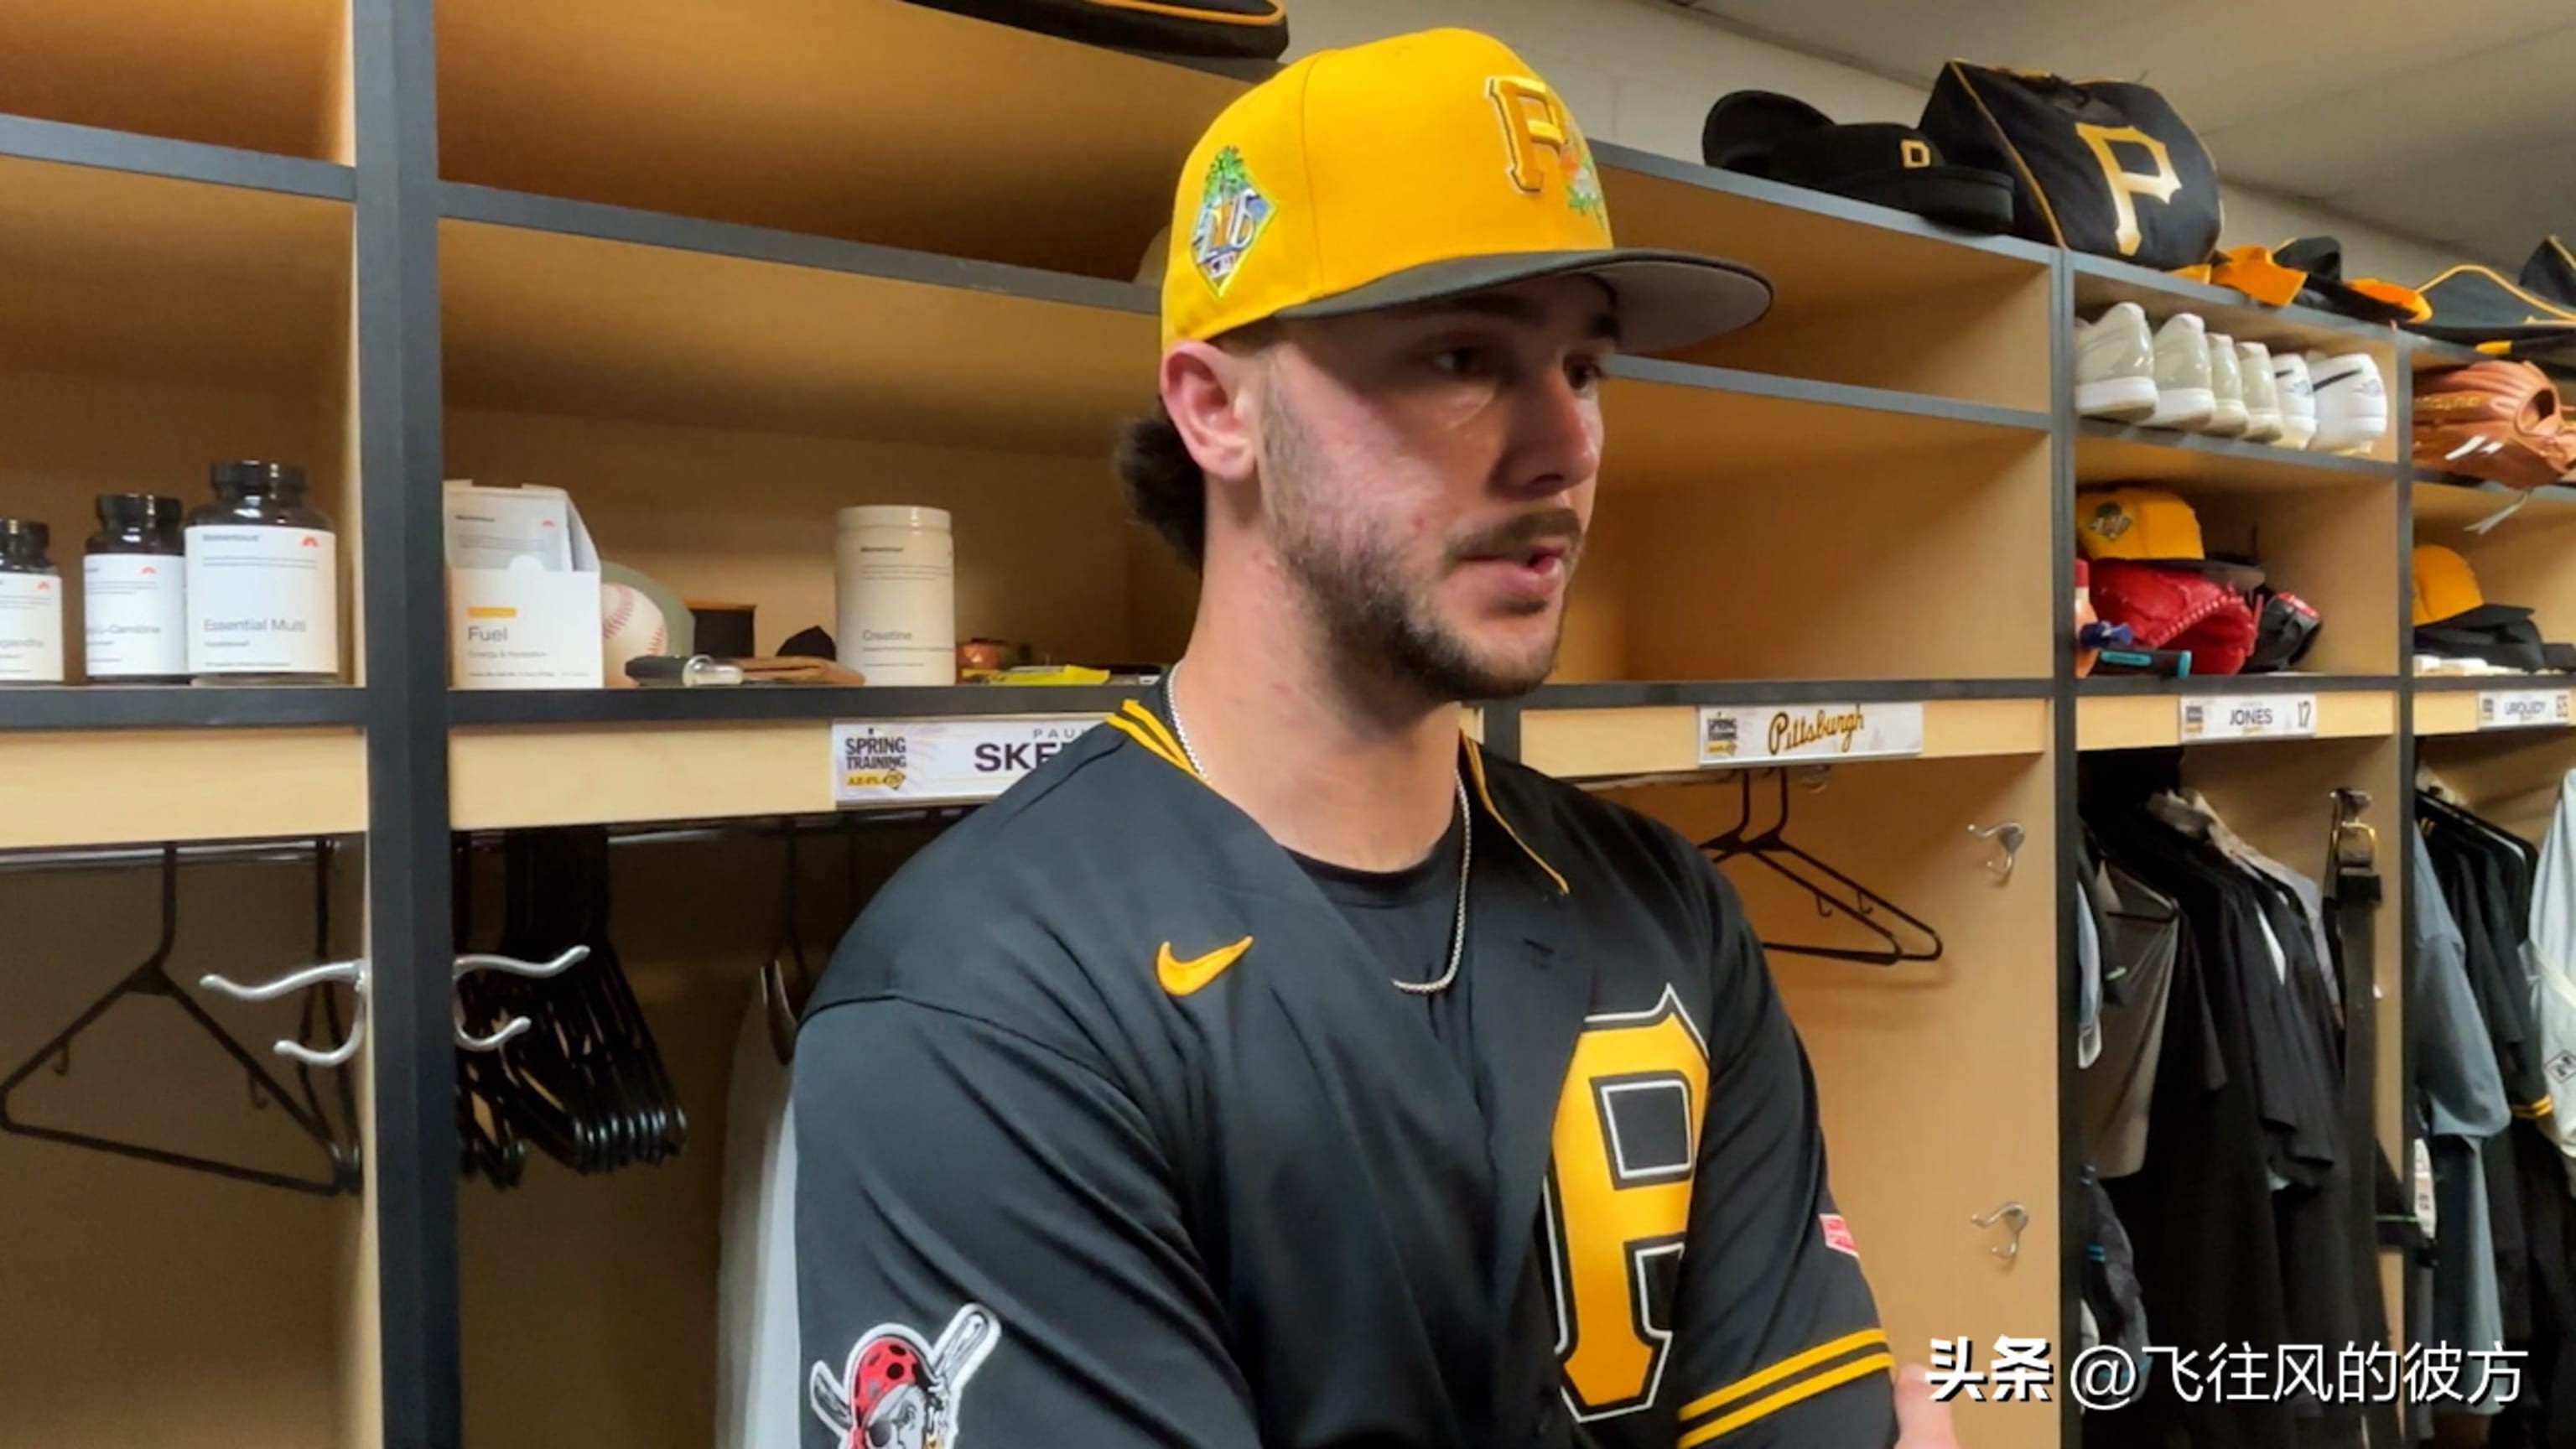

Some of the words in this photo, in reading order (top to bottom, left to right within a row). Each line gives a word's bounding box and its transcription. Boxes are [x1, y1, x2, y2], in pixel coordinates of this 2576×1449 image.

[2075, 122, 2183, 257] P
[203, 618, 267, 632] Essential
[468, 625, 508, 643] Fuel
[2230, 708, 2273, 725] JONES
[2298, 699, 2312, 729] 17
[1768, 702, 1864, 755] Pittsburgh
[845, 736, 906, 755] SPRING
[845, 755, 907, 770] TRAINING
[1544, 983, 1711, 1424] P
